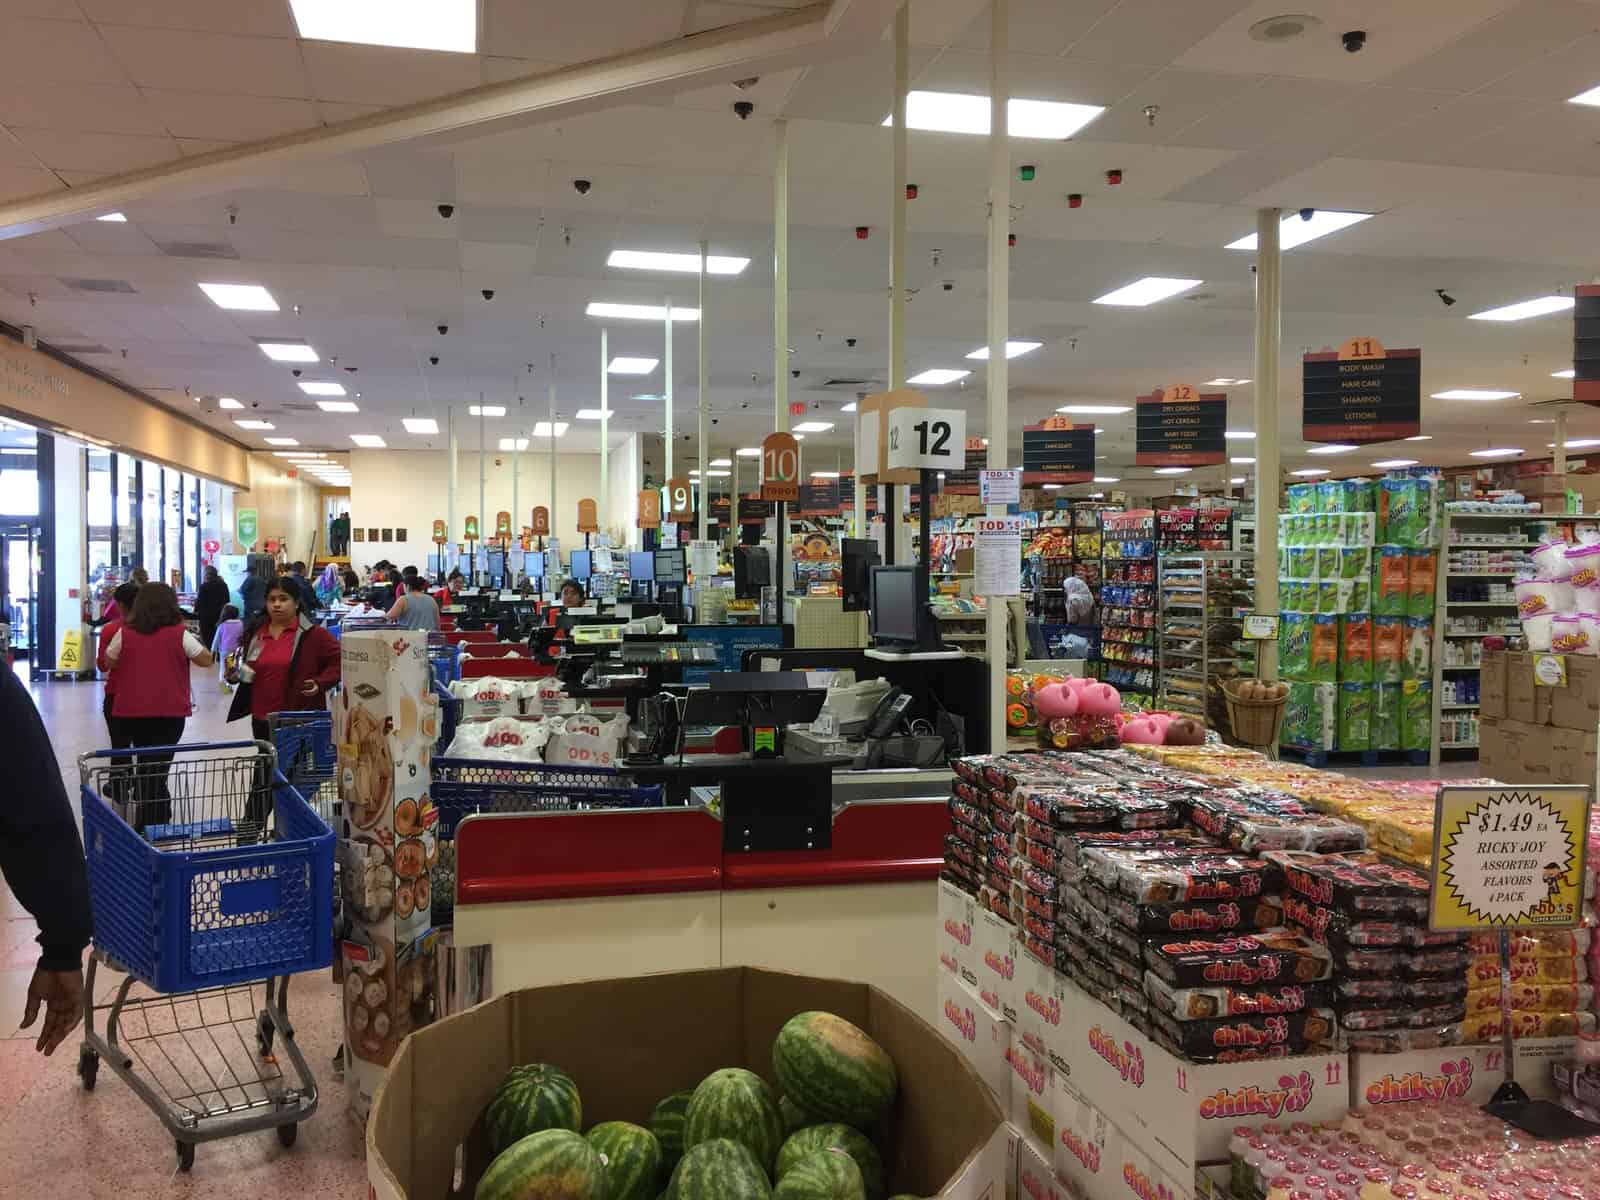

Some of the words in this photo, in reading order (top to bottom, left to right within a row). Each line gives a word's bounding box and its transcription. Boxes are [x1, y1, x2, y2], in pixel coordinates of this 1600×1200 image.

[1351, 341, 1375, 357] 11
[1174, 387, 1191, 399] 12
[1053, 418, 1066, 428] 13
[890, 426, 899, 451] 12
[913, 420, 951, 456] 12
[766, 449, 797, 481] 10
[674, 487, 687, 511] 9
[766, 487, 797, 496] TODOS
[569, 747, 609, 763] ODOS
[1478, 812, 1533, 834] $1.49
[1537, 823, 1548, 832] EA
[1477, 842, 1518, 854] RICKY
[1520, 841, 1547, 853] JOY
[1480, 860, 1538, 871] ASSORTED
[1483, 876, 1533, 887] FLAVORS
[1496, 892, 1526, 902] PACK
[1366, 1072, 1451, 1104] chiky
[1199, 1086, 1289, 1119] chiky
